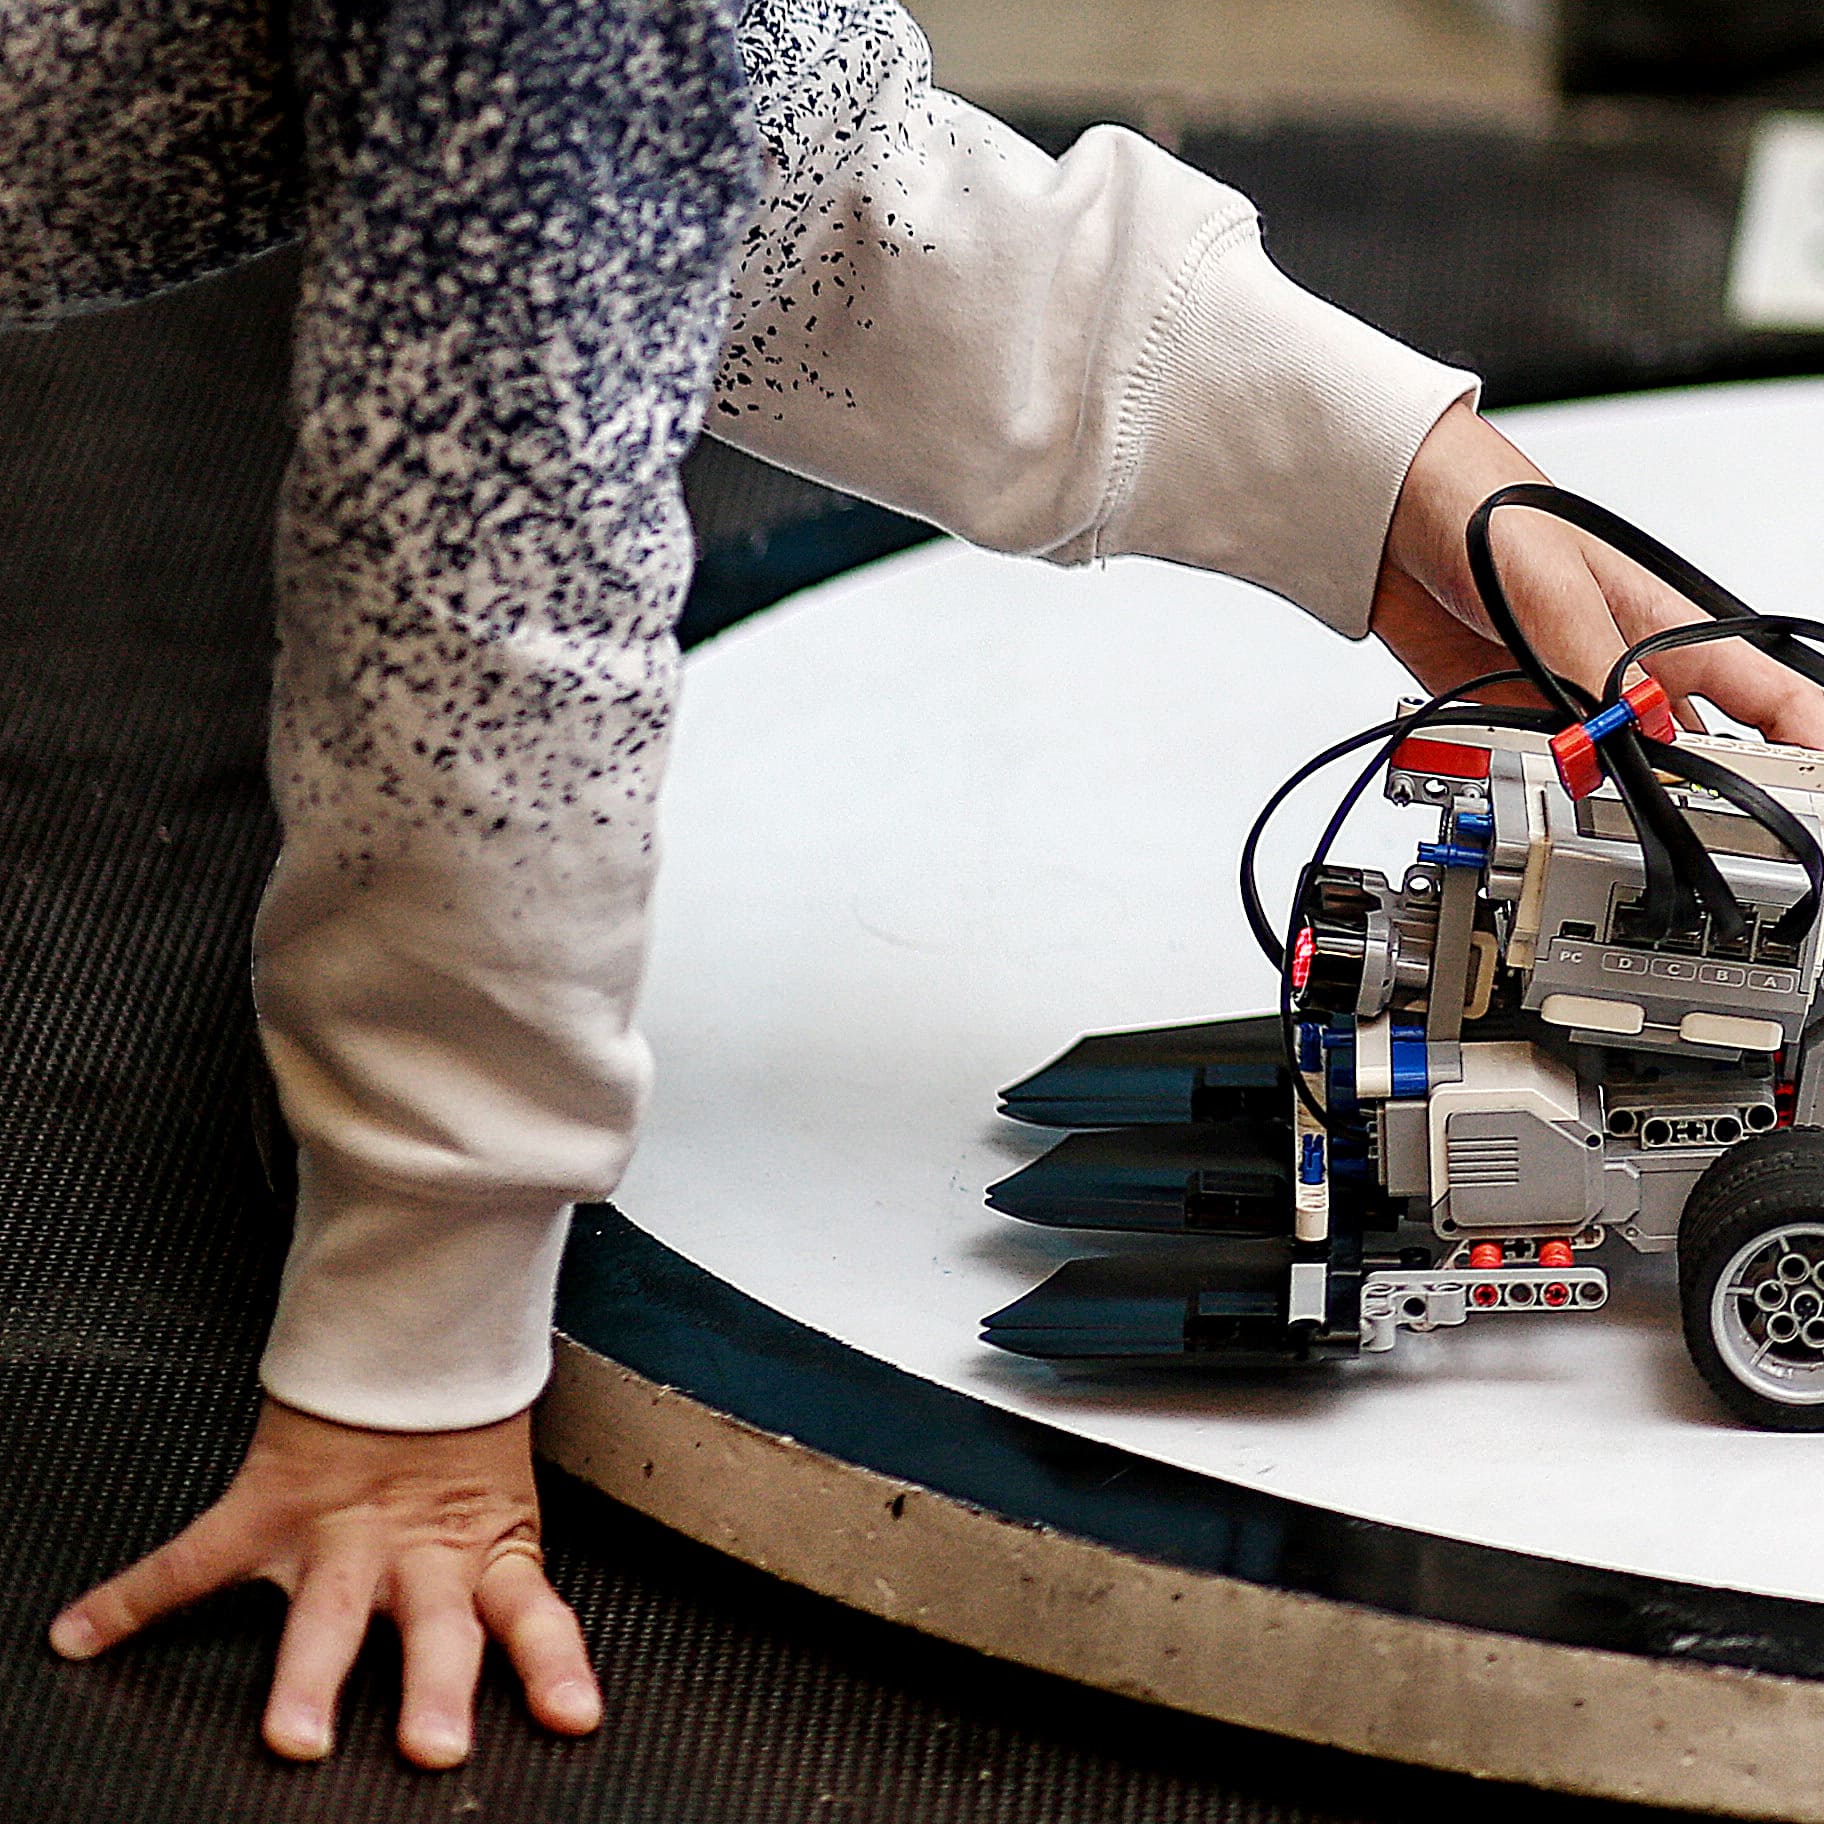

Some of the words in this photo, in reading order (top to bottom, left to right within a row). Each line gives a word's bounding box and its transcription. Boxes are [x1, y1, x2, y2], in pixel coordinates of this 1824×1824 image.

[1559, 949, 1583, 964] PC
[1617, 957, 1633, 970] D
[1667, 963, 1681, 976] C
[1715, 969, 1729, 982] B
[1763, 975, 1778, 988] A
